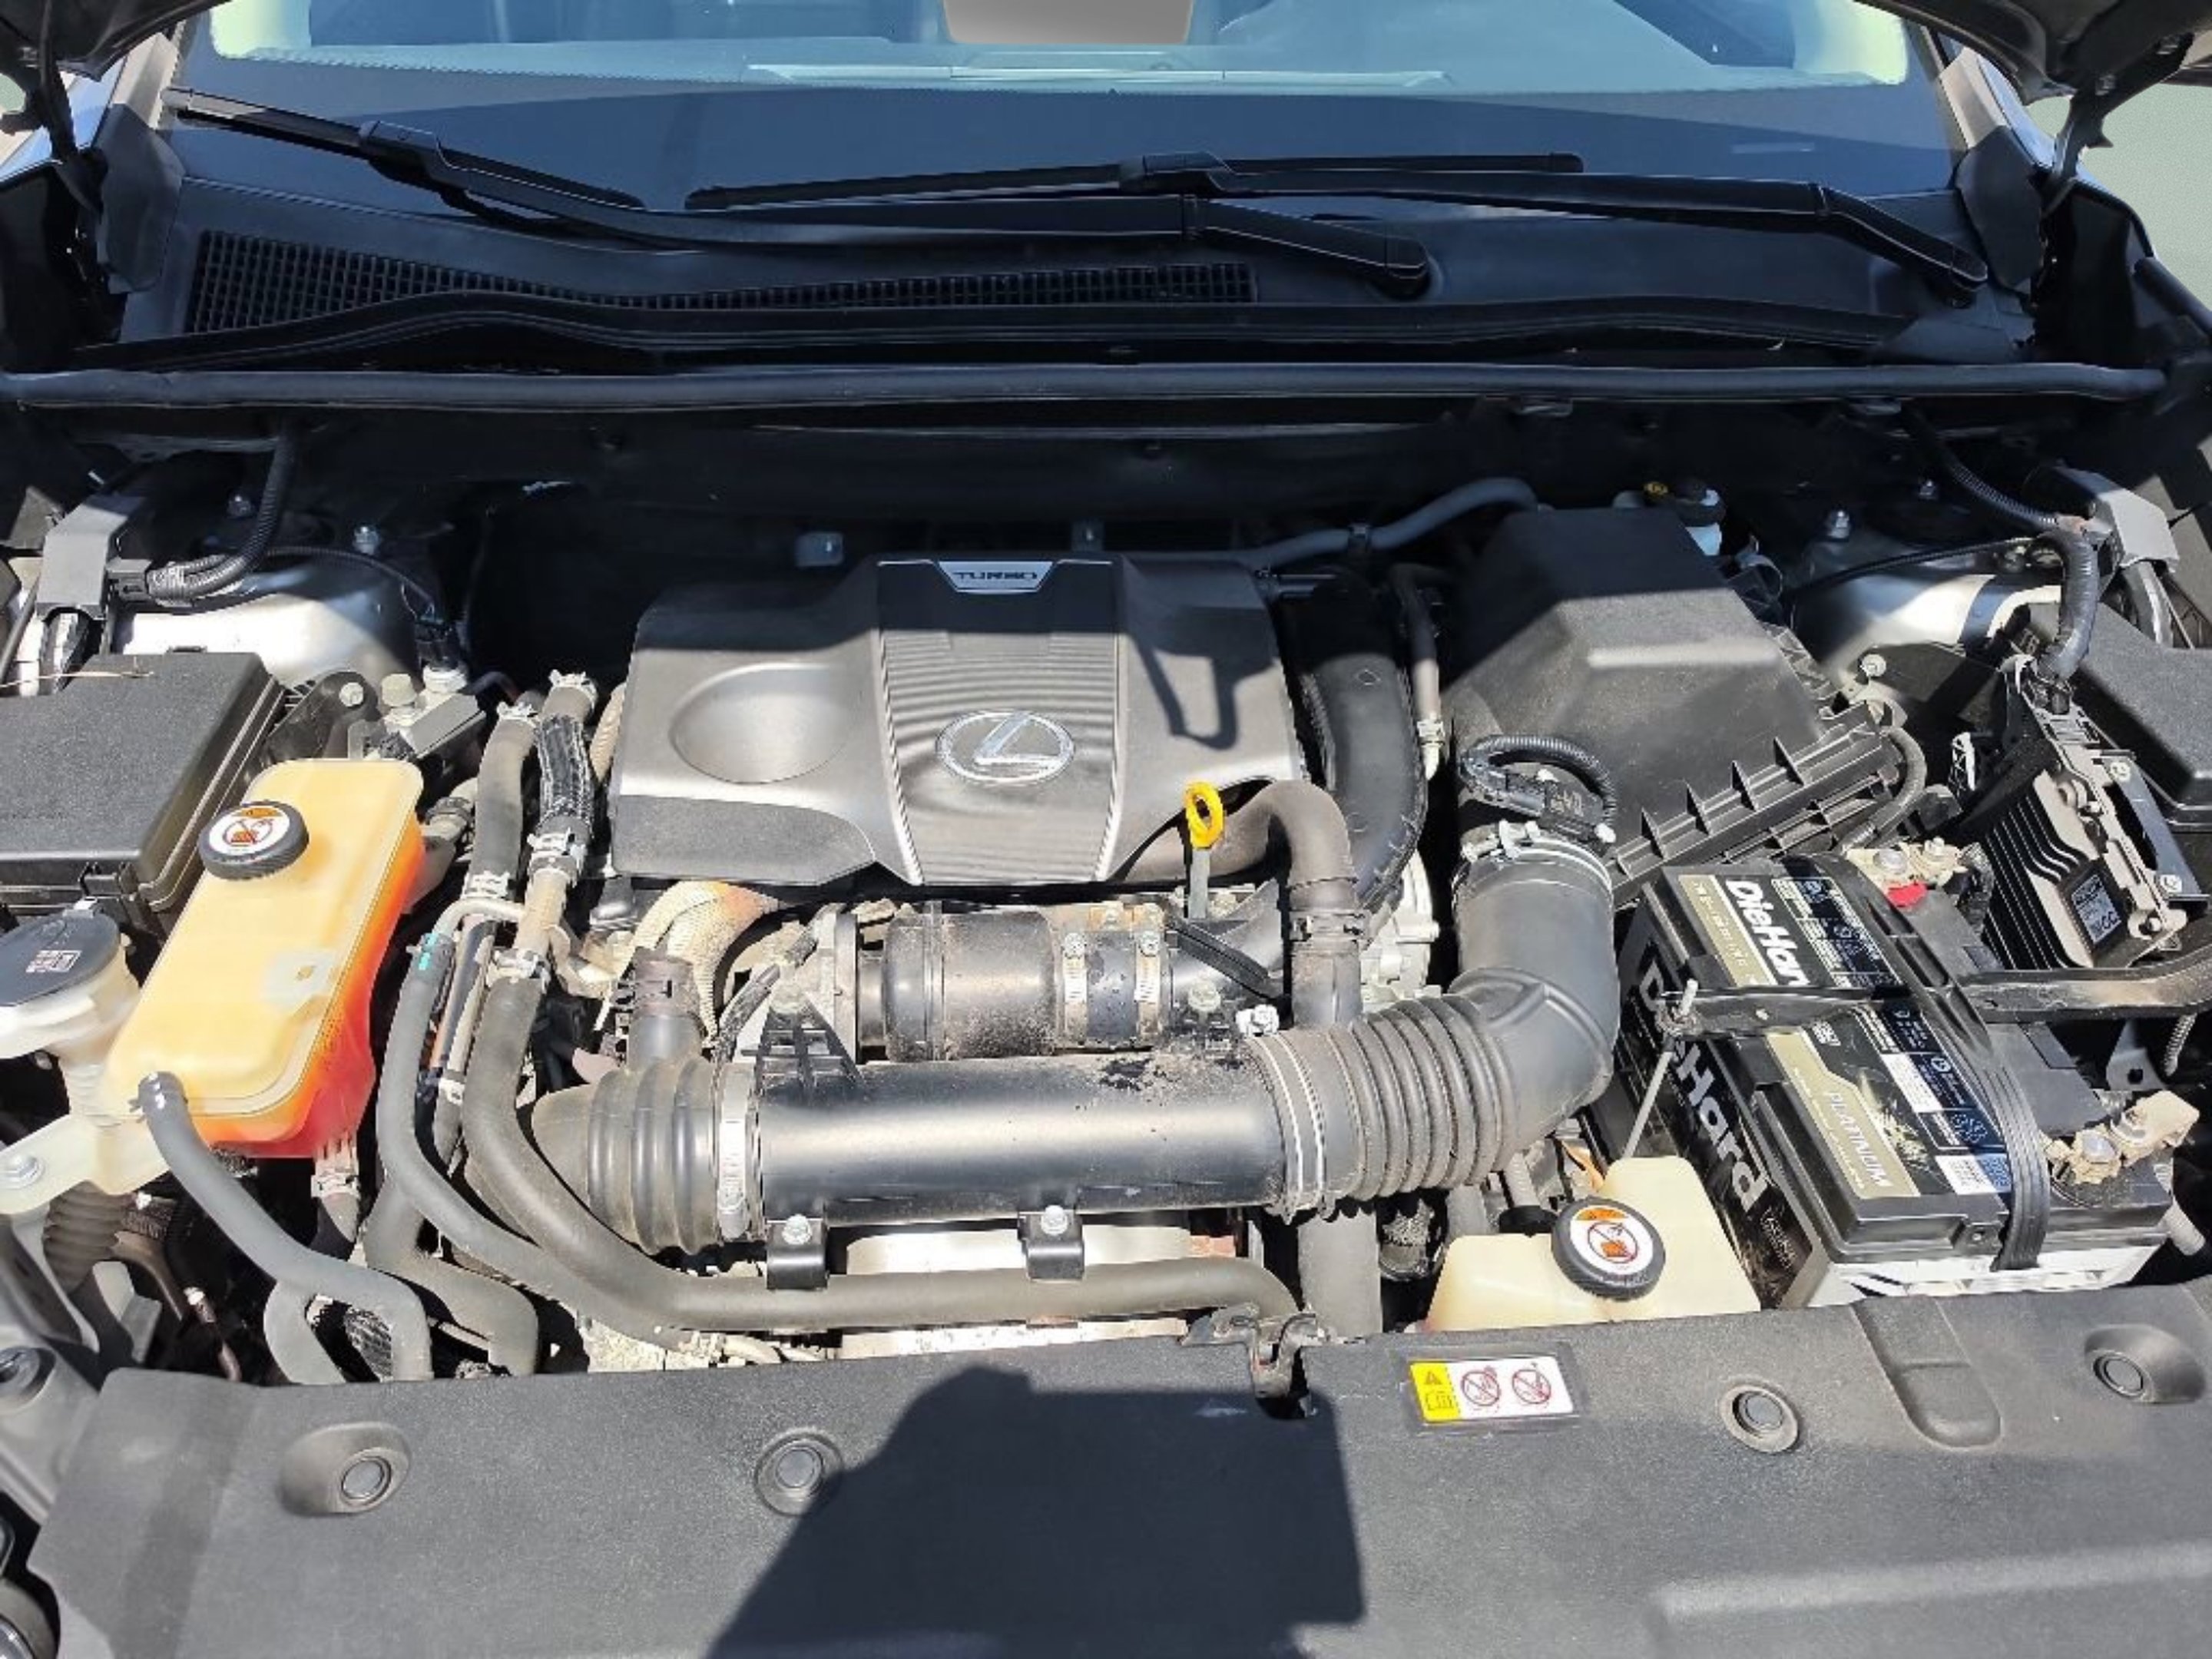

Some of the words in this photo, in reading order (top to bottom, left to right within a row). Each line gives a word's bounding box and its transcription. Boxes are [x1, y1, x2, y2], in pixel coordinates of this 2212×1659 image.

[952, 571, 1038, 580] TURBO
[1725, 880, 1810, 987] DieHar
[1639, 959, 1768, 1213] DHard
[1823, 1090, 1893, 1188] PLATINUM
